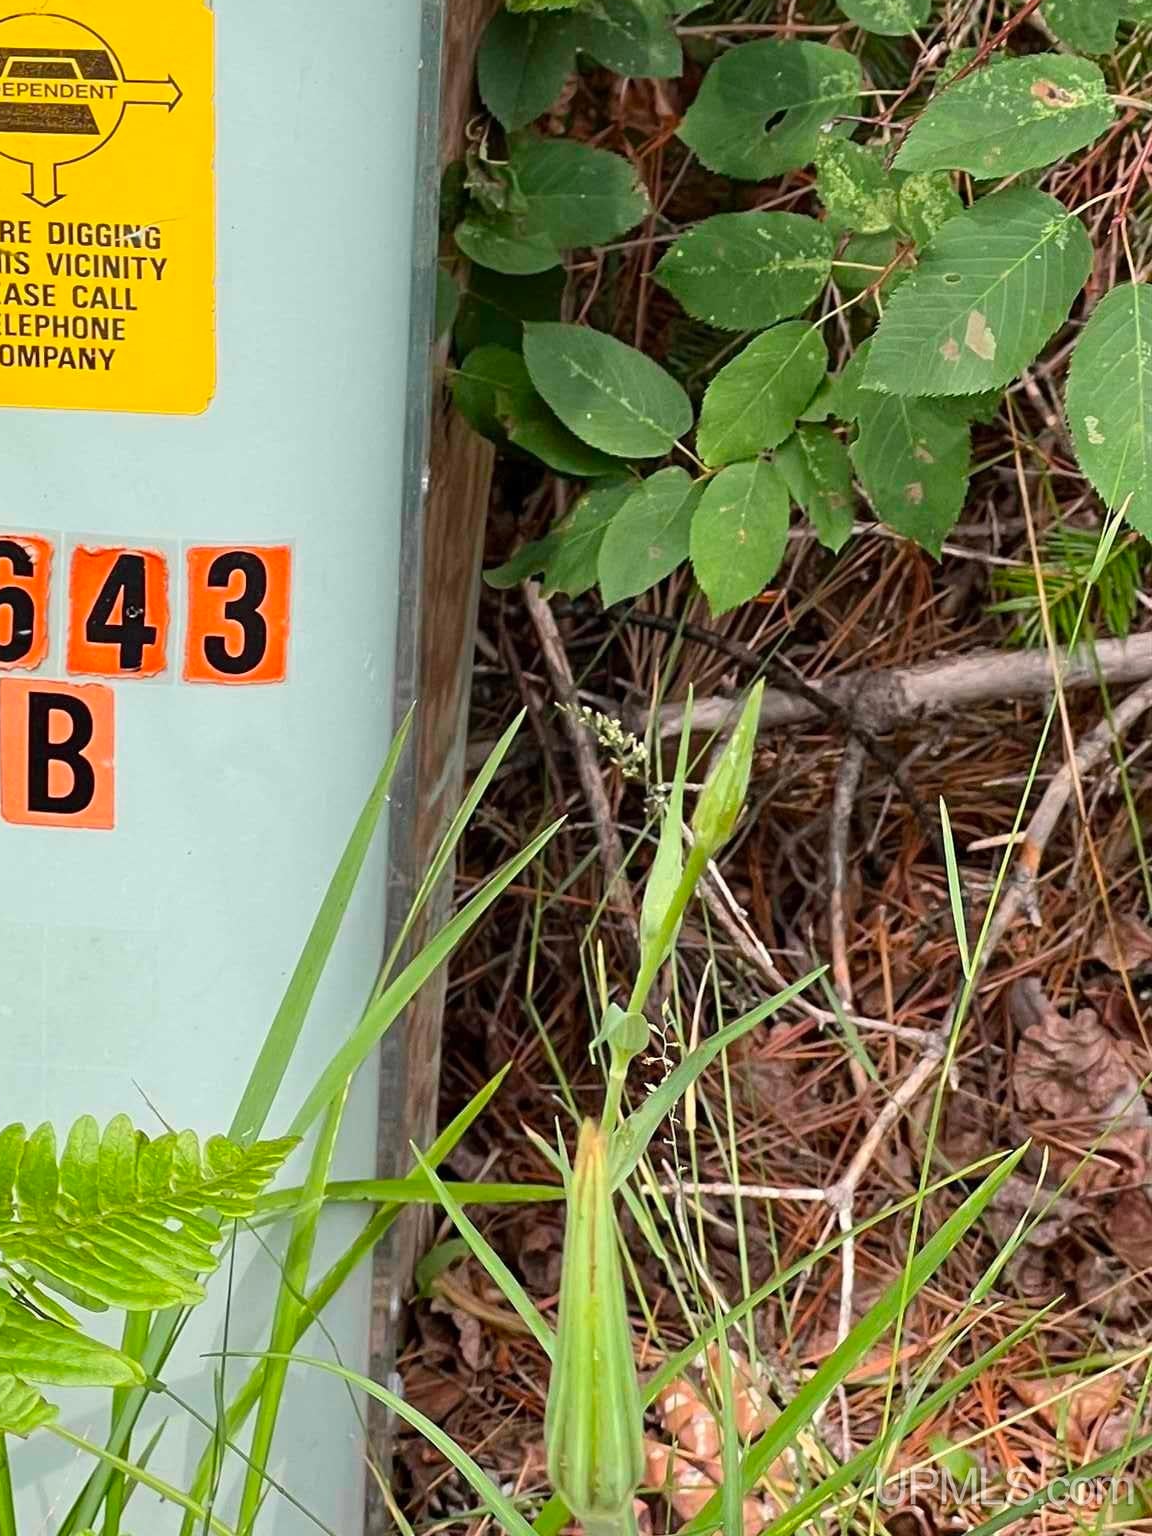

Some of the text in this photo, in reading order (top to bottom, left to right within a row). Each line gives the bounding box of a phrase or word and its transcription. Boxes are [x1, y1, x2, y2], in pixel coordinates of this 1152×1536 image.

[48, 222, 160, 249] DIGGING
[46, 253, 167, 281] VICINITY
[71, 285, 137, 311] CALL
[27, 690, 95, 814] B
